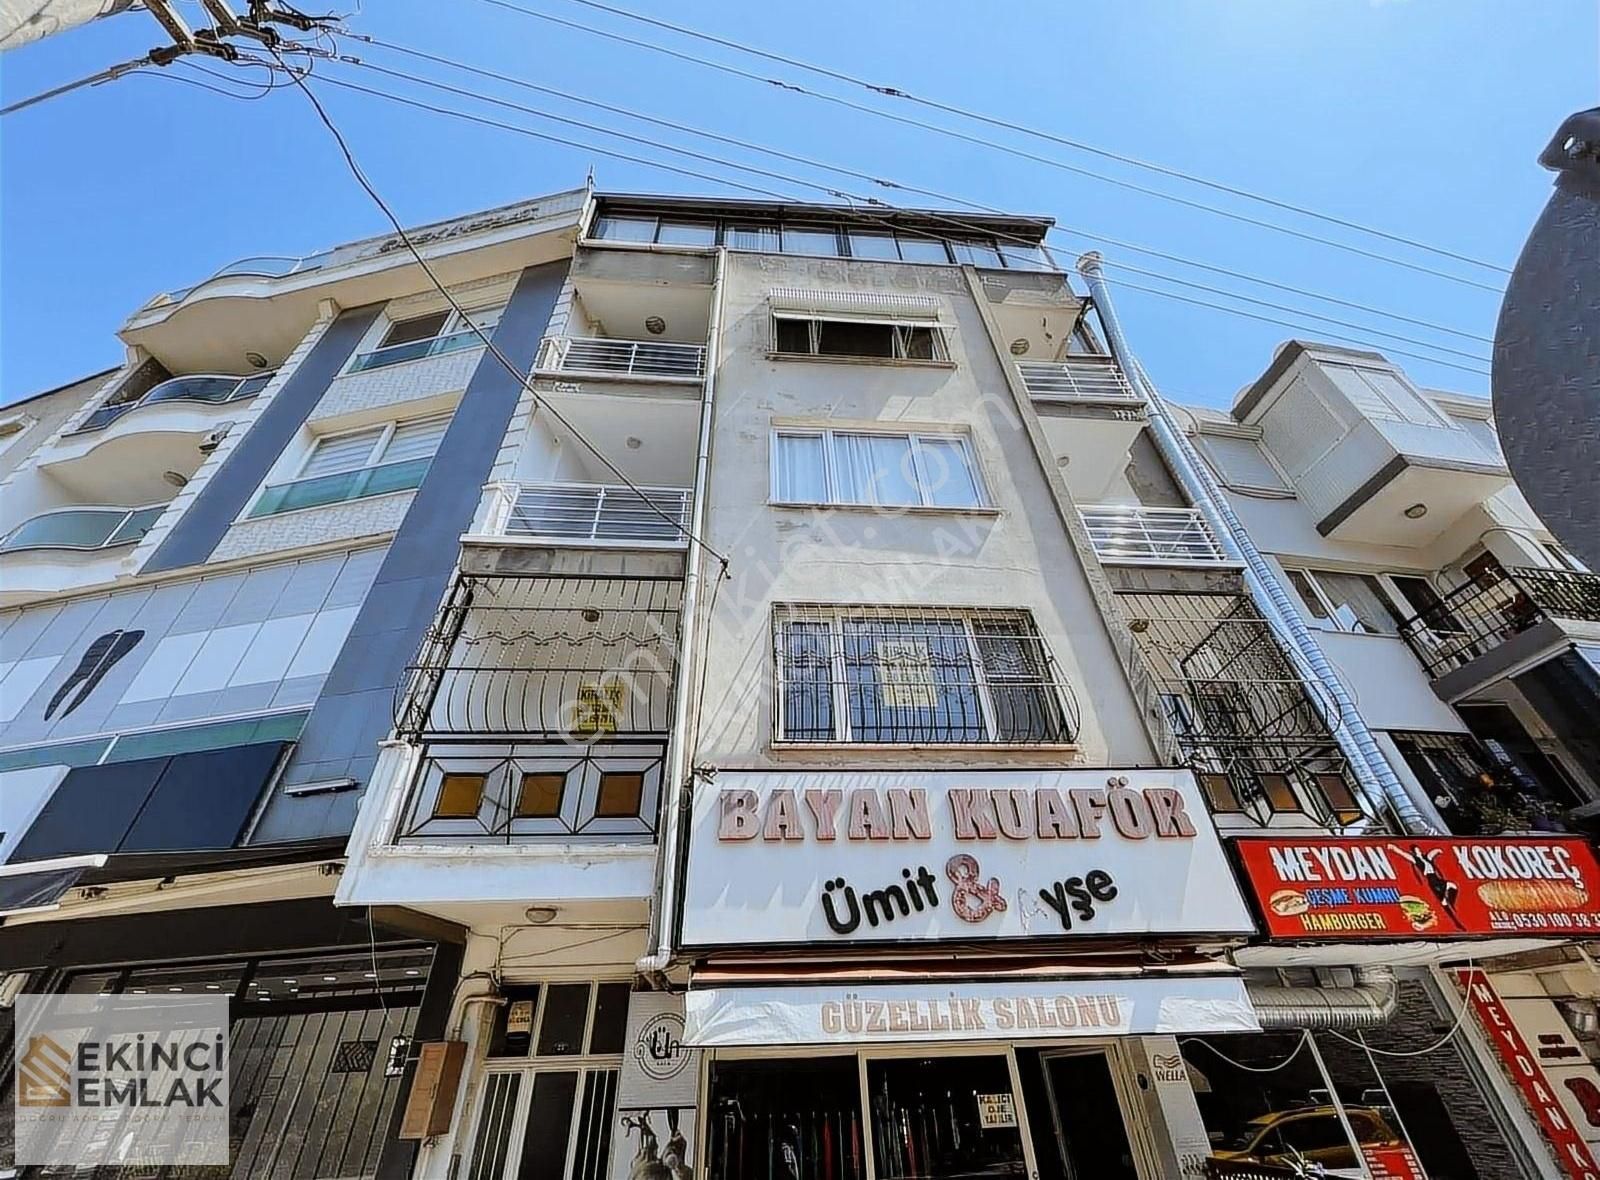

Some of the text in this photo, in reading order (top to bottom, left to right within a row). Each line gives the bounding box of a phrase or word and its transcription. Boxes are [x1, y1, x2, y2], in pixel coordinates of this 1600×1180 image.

[718, 777, 1198, 841] BAYAN KUAFÖR
[1269, 845, 1582, 889] MEYDAN KOKOREÇ
[821, 853, 1118, 935] Ümit & yşe
[1300, 913, 1387, 931] HAMBURGER
[1513, 913, 1547, 928] 0530
[1548, 913, 1572, 928] 100
[821, 991, 1122, 1033] GÜZELLİK SALONU
[1155, 1069, 1187, 1082] WELLA
[1471, 983, 1567, 1130] MEYDAN
